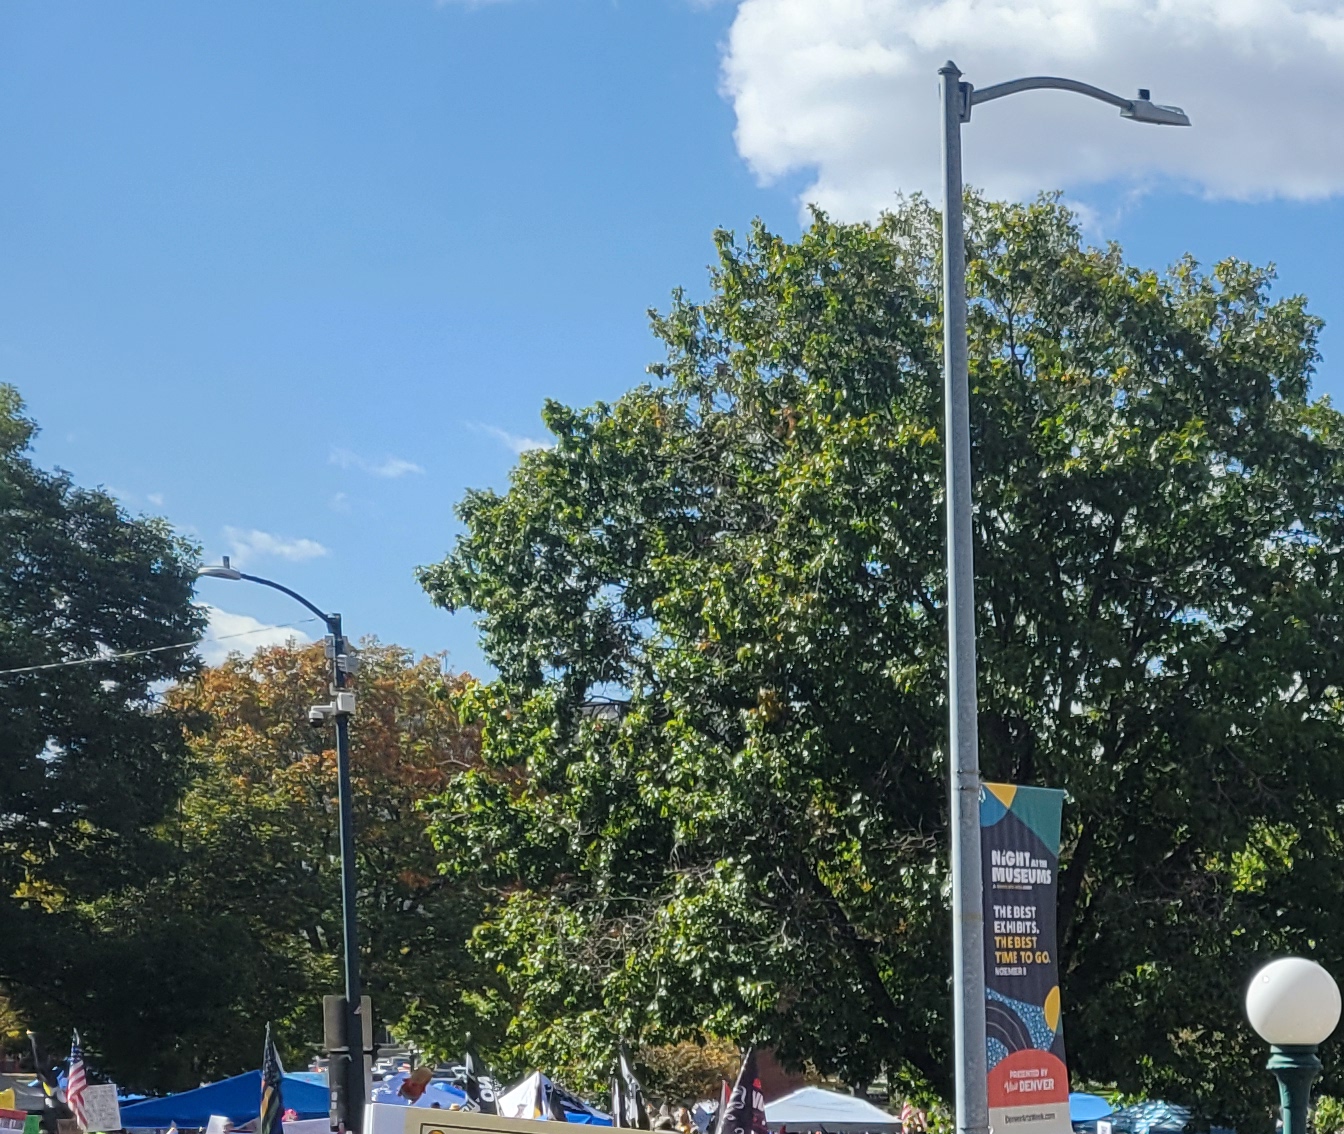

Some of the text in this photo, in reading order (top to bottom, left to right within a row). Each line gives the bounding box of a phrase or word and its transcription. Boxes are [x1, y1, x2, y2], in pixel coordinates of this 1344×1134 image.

[991, 867, 1051, 885] MUSEUMS
[993, 905, 1036, 919] THE BEST
[993, 921, 1040, 934] EXHIBITS.
[994, 936, 1037, 949] THE BEST
[995, 951, 1051, 964] TIME TO GO.
[1009, 1068, 1048, 1079] PRESENTED BY
[1019, 1078, 1054, 1092] DENVER
